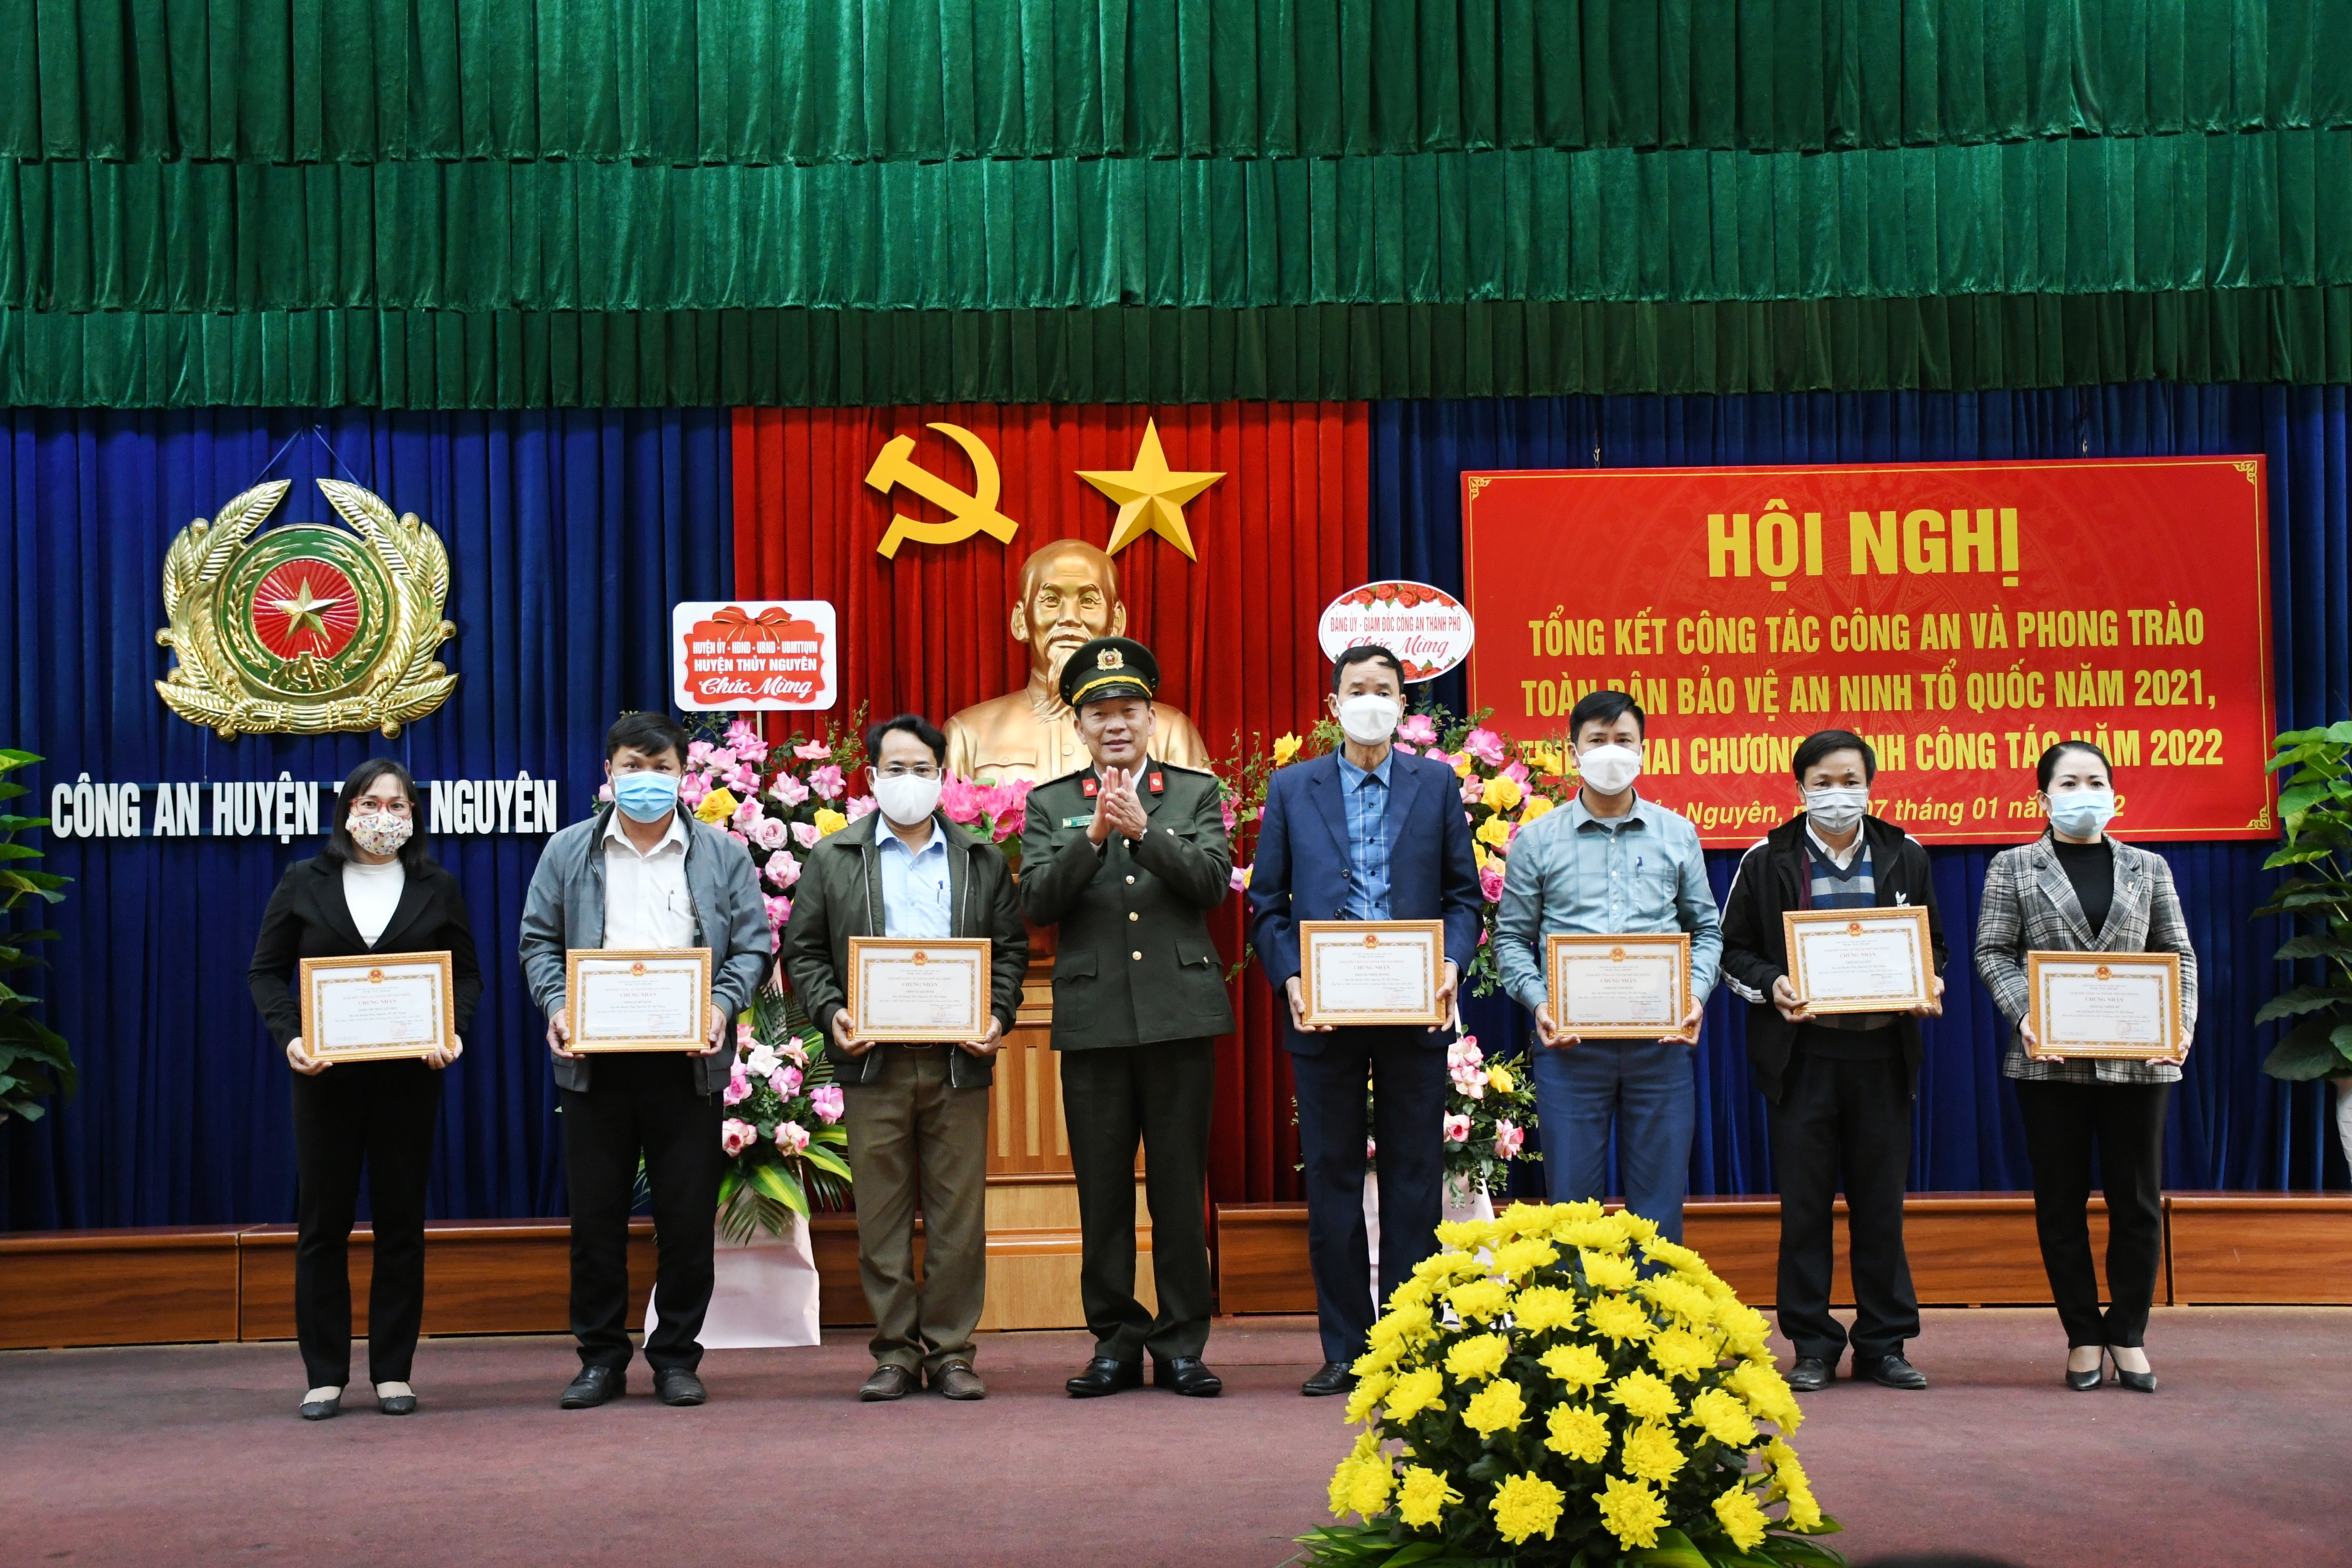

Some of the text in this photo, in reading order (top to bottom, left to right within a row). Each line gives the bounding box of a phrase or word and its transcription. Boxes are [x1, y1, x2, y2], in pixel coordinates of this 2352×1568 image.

[1708, 499, 2019, 591] HỘI NGHỊ
[1330, 612, 1348, 632] ĐẢNG
[1364, 613, 1380, 632] GIÁM
[1382, 611, 1395, 632] ĐỐC
[1397, 613, 1414, 632] CÔNG
[1415, 616, 1424, 632] AN
[1426, 612, 1446, 632] THÀNH
[1449, 610, 1461, 632] PHỐ
[1528, 601, 2204, 656] TỔNG KẾT CÔNG TÁC CÔNG AN VÀ PHONG TRÀO
[693, 639, 716, 657] HUYỆN
[757, 641, 776, 654] UBND
[694, 654, 817, 674] HUYỆN THỦY NGUYÊN
[698, 675, 813, 698] Chúc Mừng
[1677, 665, 1735, 714] BẢO
[1744, 669, 1779, 721] VỆ
[1789, 676, 1830, 712] AN
[1840, 674, 1912, 711] NINH
[1921, 658, 1957, 710] TỔ
[1967, 658, 2045, 714] QUỐC
[2055, 662, 2124, 707] NĂM
[2135, 669, 2216, 710] 2021,
[1916, 726, 1996, 771] CÔNG
[2150, 728, 2223, 766] 2022
[52, 770, 556, 844] CÔNG AN HUYỆN NGUYÊN
[1895, 796, 1964, 826] tháng
[1972, 797, 1998, 819] 01
[2008, 795, 2050, 818] nă
